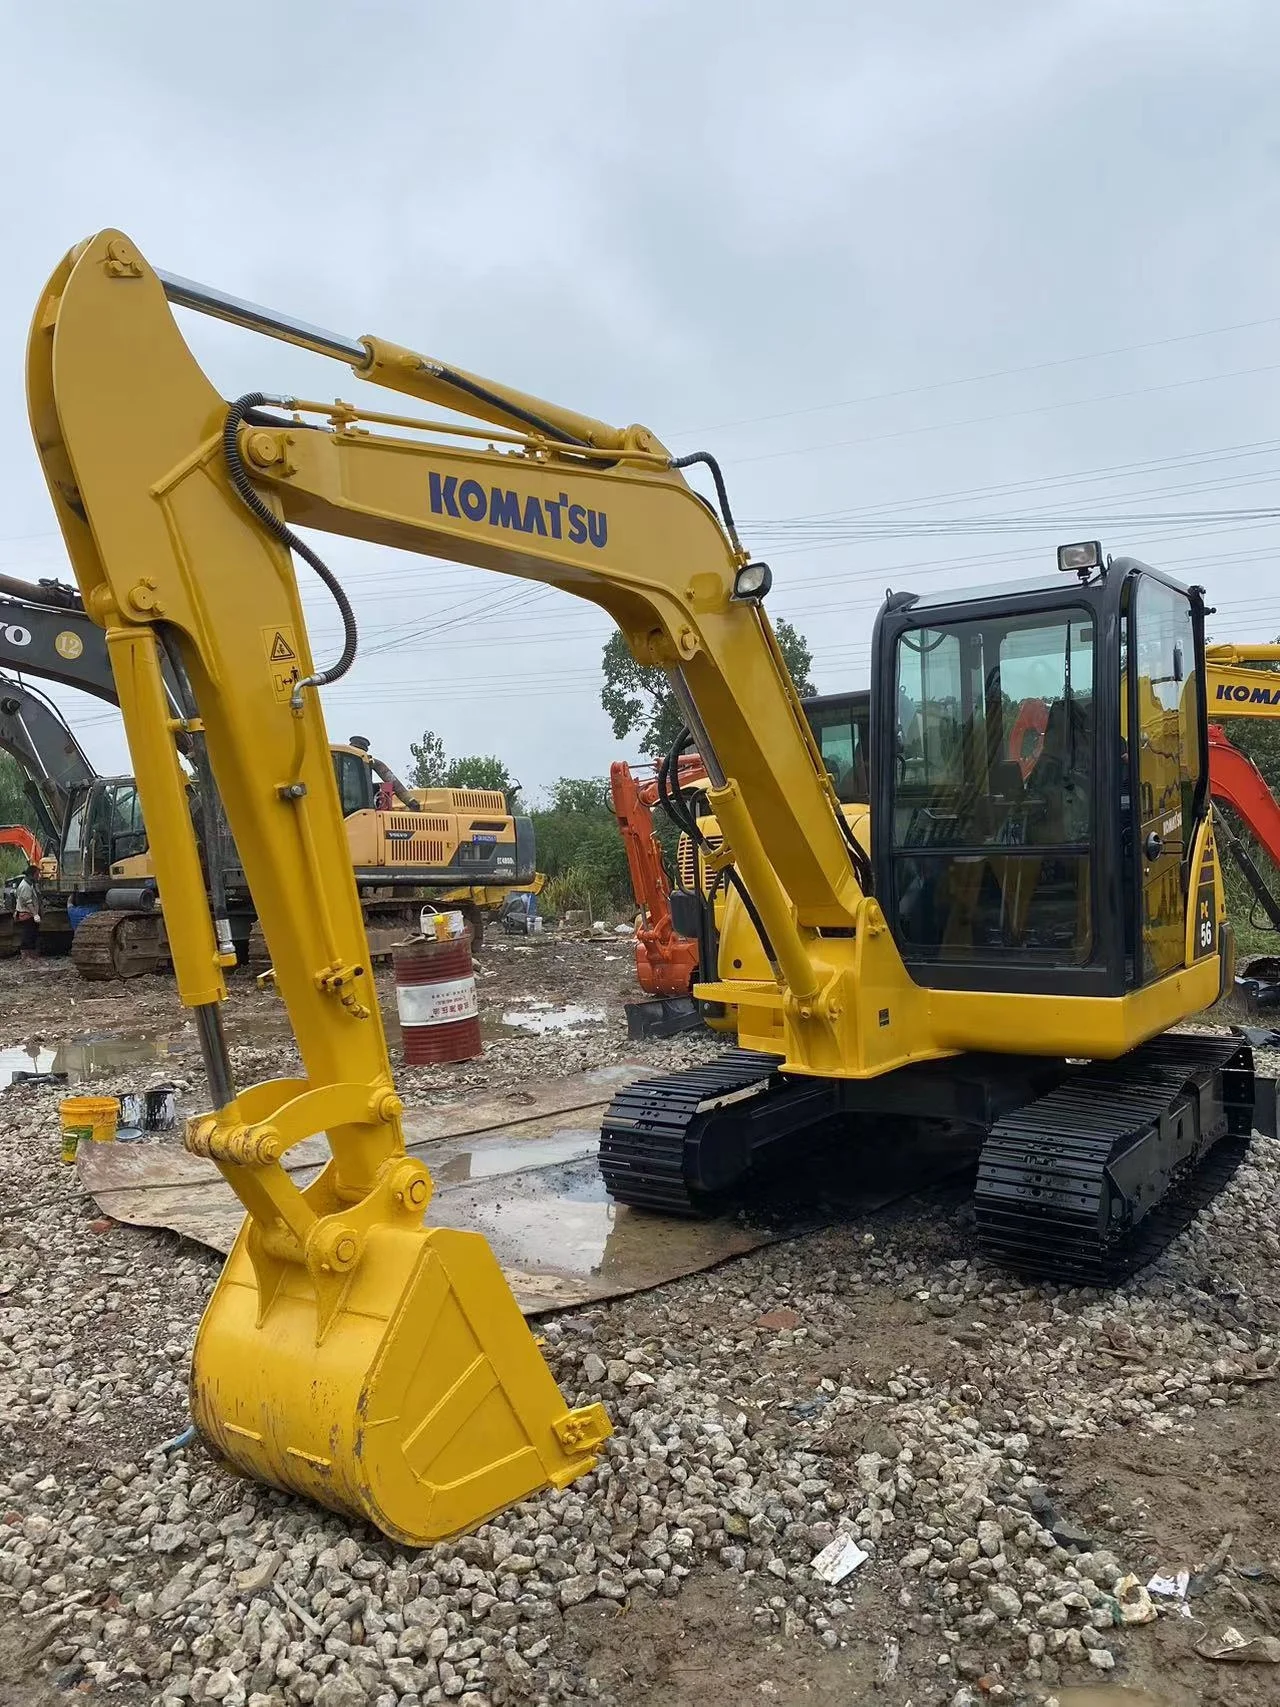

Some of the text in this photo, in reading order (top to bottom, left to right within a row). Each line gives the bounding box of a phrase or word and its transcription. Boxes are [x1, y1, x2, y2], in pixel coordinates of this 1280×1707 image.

[428, 471, 608, 549] KOMATSU
[59, 635, 81, 656] 12
[1201, 920, 1211, 947] 56
